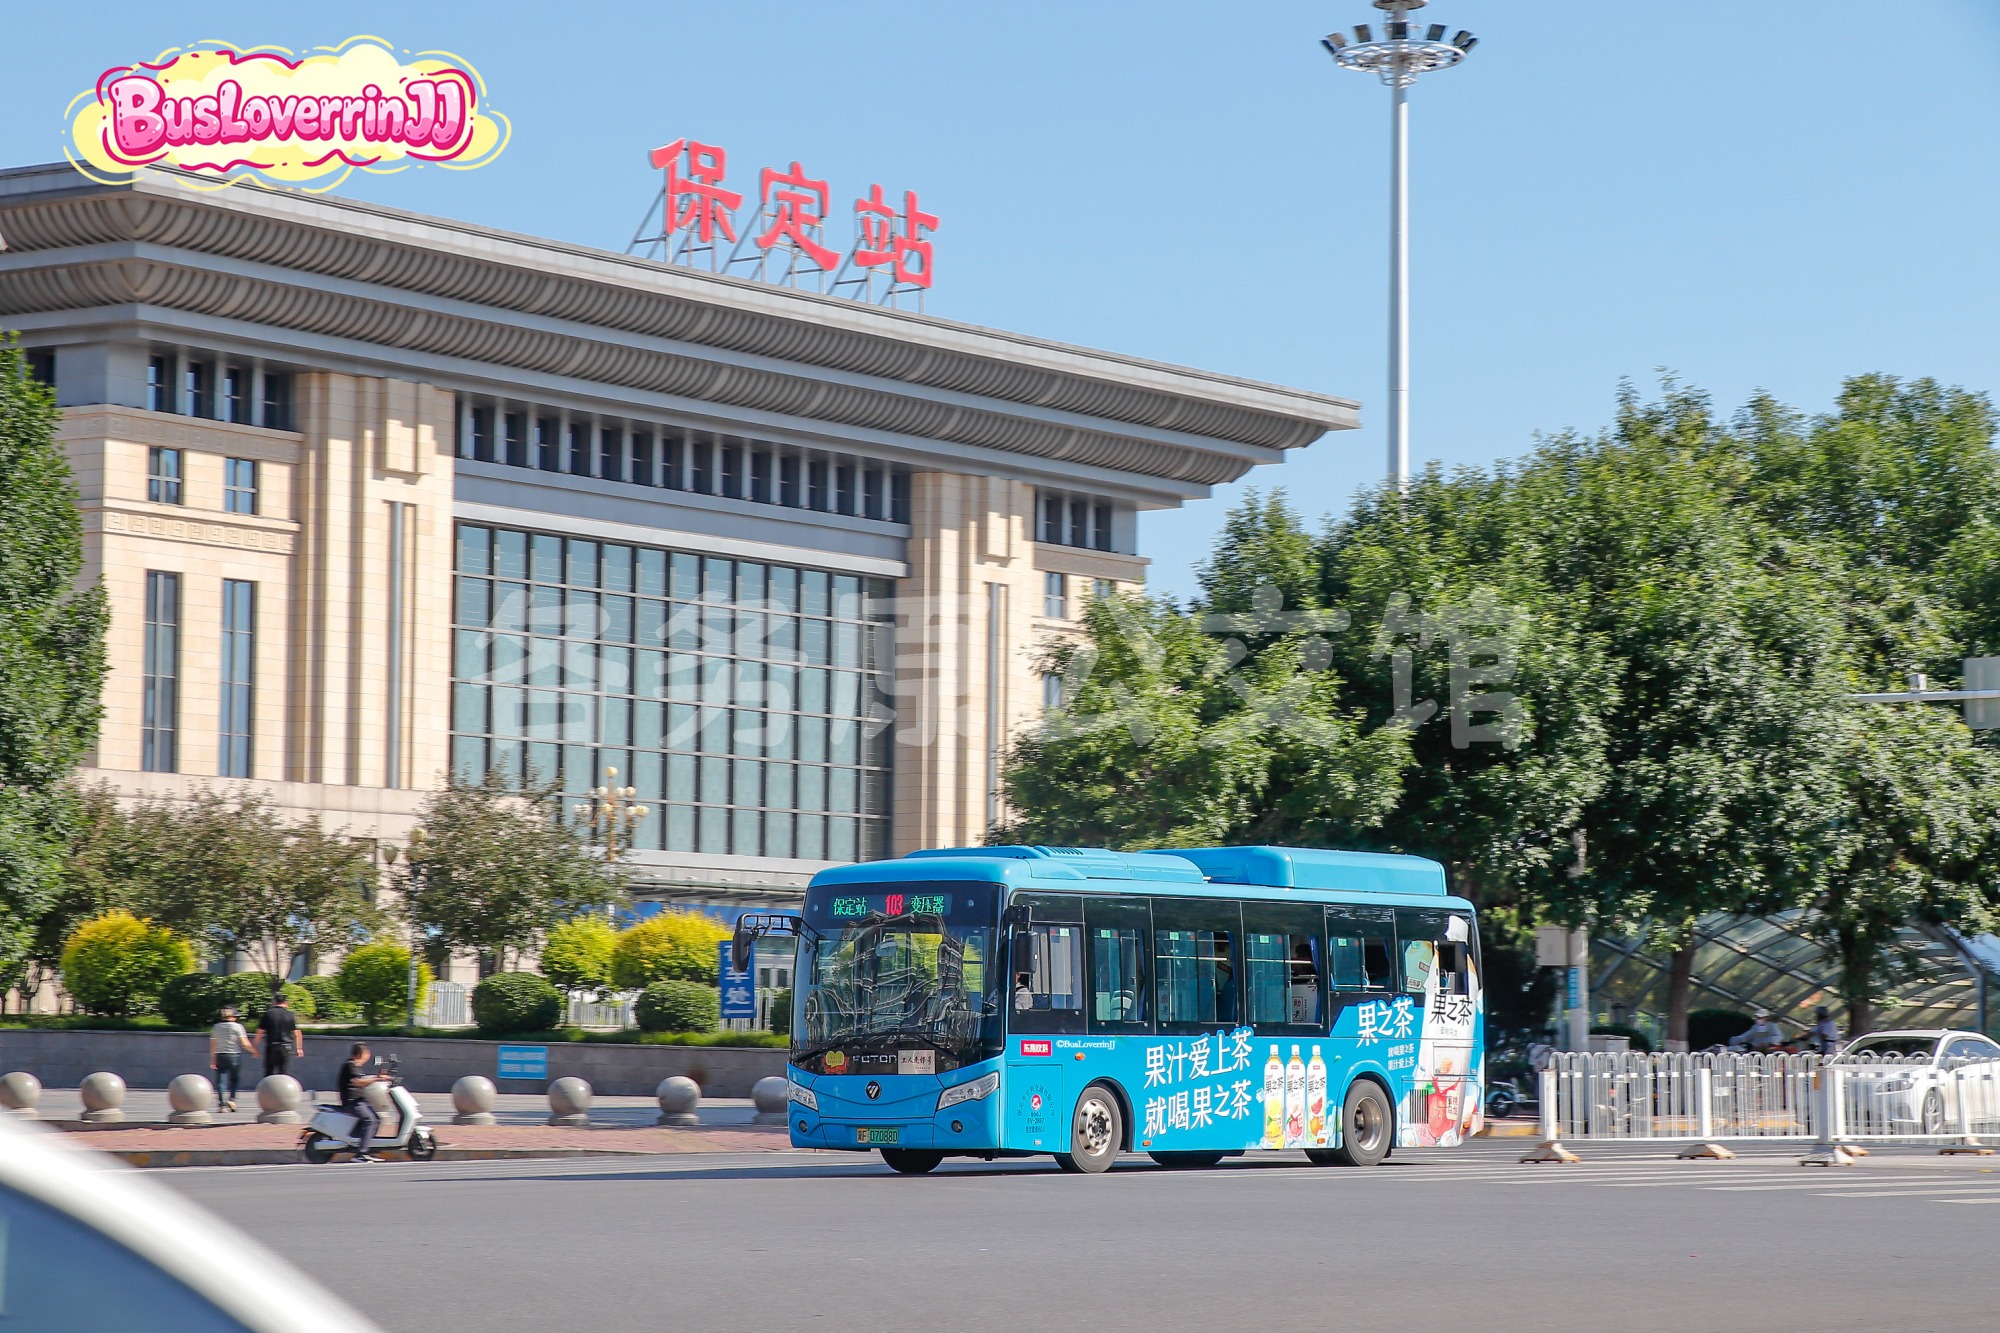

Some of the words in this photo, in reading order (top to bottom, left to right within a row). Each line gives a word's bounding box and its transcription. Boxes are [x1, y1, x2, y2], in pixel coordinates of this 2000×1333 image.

[649, 138, 940, 288] 保定站
[833, 897, 867, 917] 保定站
[885, 894, 904, 915] 103
[911, 895, 945, 915] 变压器
[1356, 998, 1414, 1048] 果之茶
[1429, 993, 1473, 1026] 果之茶
[852, 1054, 898, 1063] FOTON
[1143, 1029, 1252, 1090] 果汁爱上茶
[1143, 1079, 1252, 1138] 就喝果之茶
